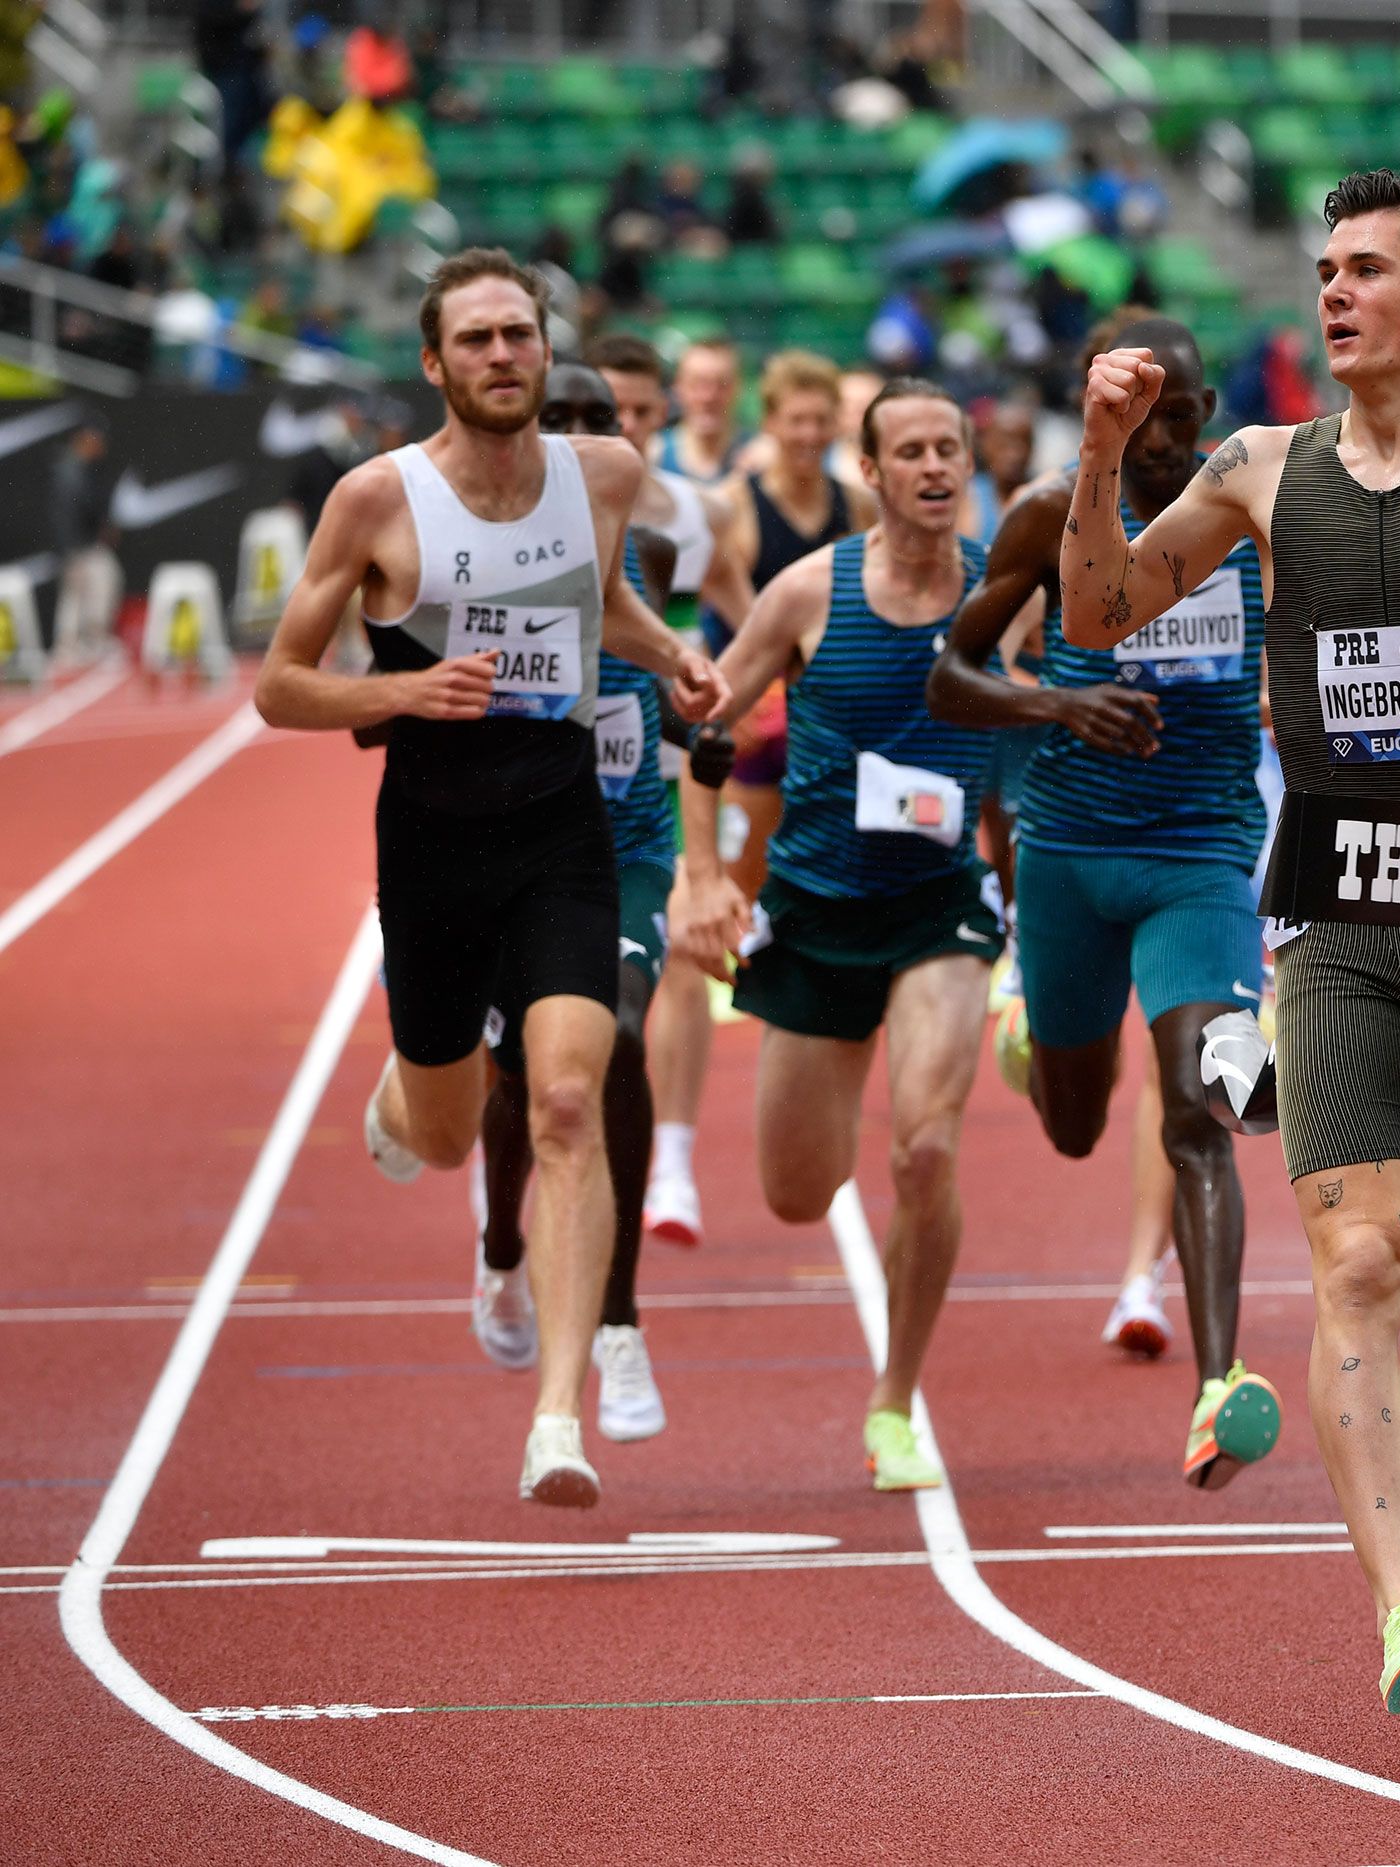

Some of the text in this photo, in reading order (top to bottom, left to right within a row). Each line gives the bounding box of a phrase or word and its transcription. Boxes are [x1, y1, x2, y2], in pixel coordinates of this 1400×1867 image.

[515, 540, 566, 566] OAC
[465, 606, 507, 635] PRE
[1333, 631, 1380, 666] PRE
[475, 647, 560, 682] OARE
[1155, 661, 1215, 679] EUGENE
